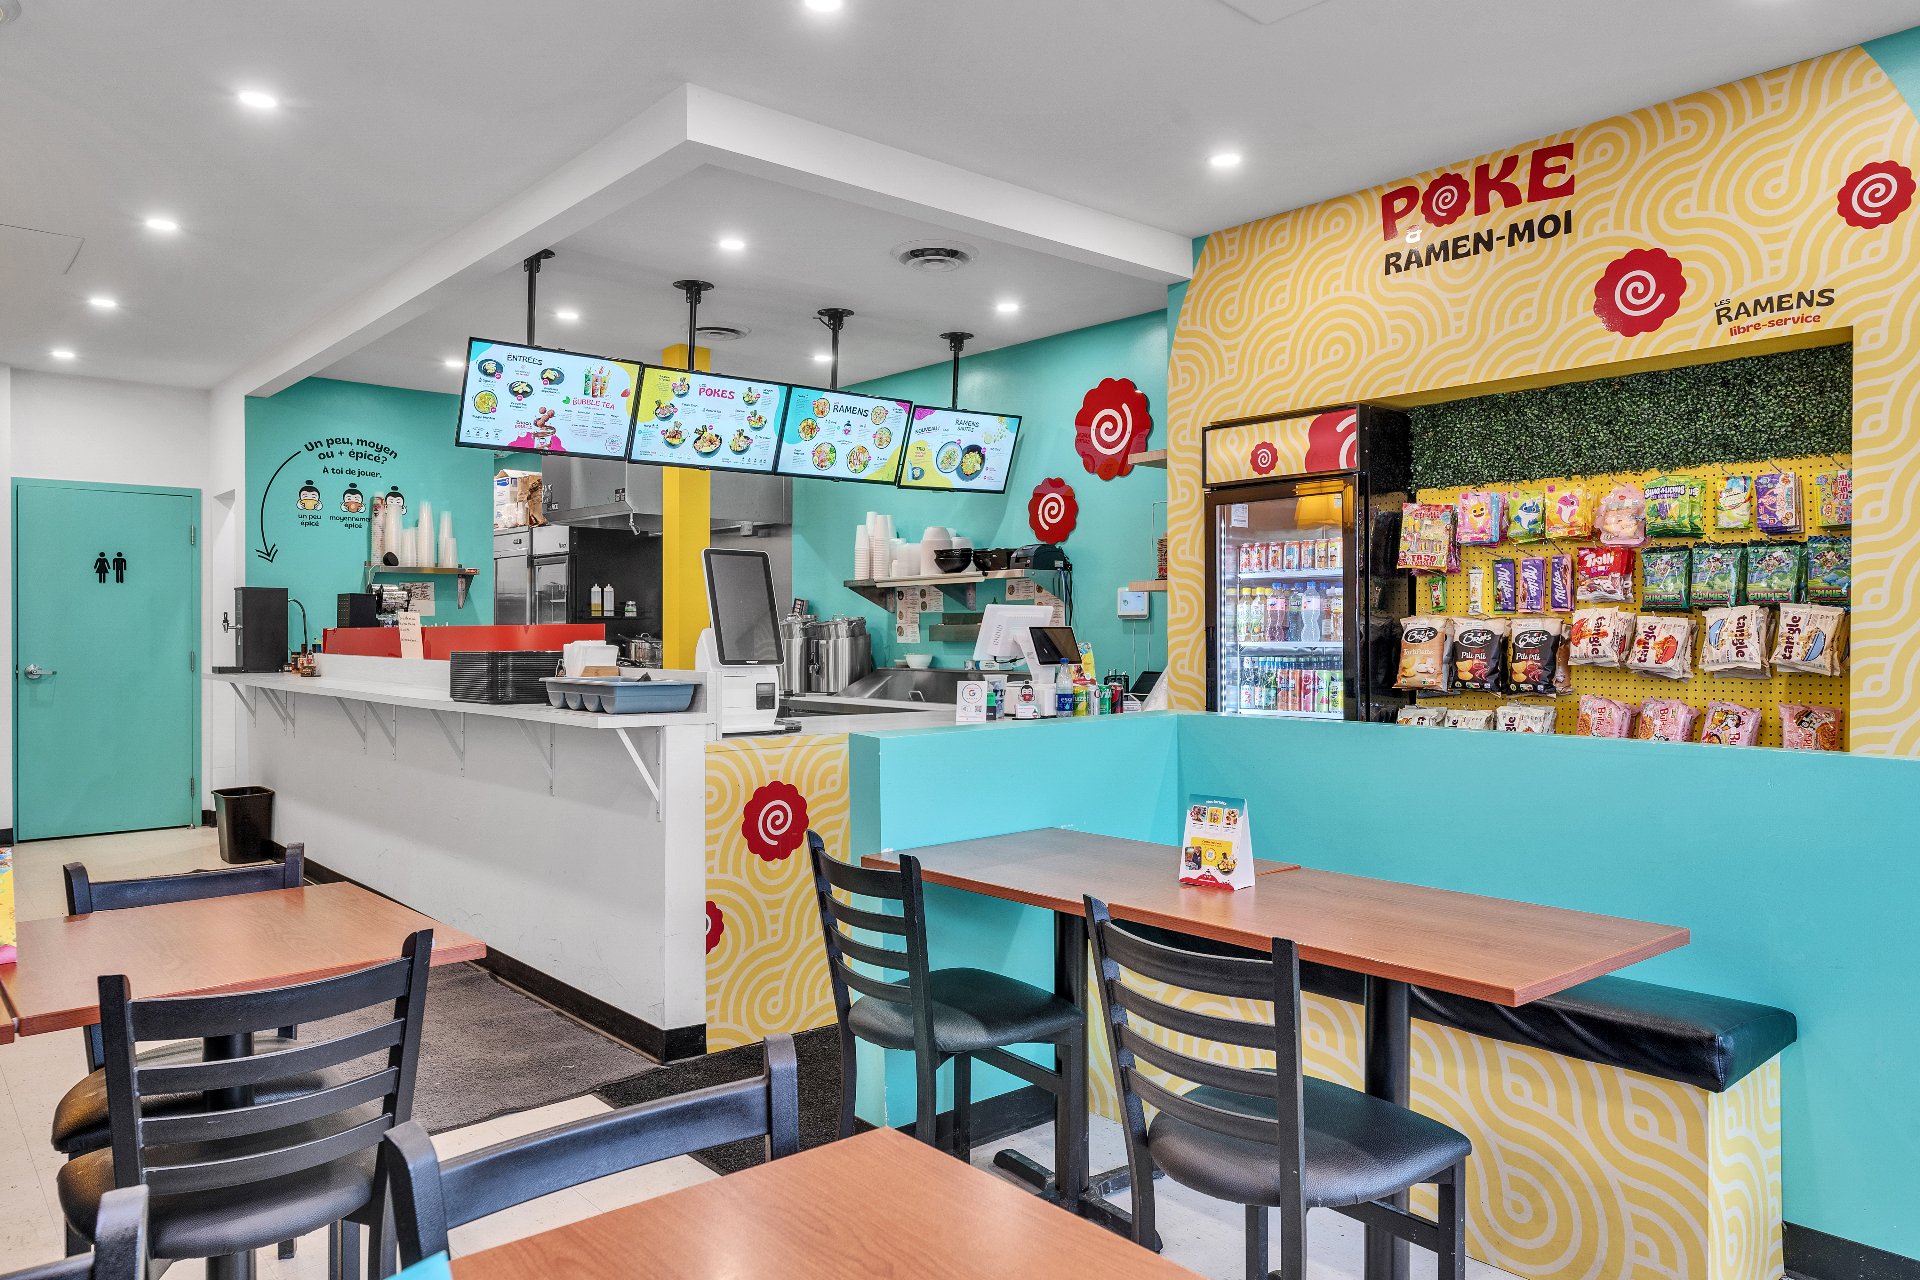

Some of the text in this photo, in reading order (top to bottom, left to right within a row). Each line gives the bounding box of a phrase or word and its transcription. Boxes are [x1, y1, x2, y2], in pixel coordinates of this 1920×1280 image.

[1384, 210, 1573, 276] RAMEN-MOI
[1714, 297, 1731, 308] LES
[1715, 288, 1836, 327] RAMENS
[1729, 313, 1821, 337] libre-service
[698, 387, 736, 400] POKES
[832, 404, 869, 418] RAMENS
[304, 435, 399, 459] Un peu, moyen
[318, 450, 335, 460] ou
[348, 448, 388, 465] épicé?
[331, 466, 343, 475] toi
[345, 467, 356, 476] de
[357, 468, 382, 479] jouer.
[1584, 551, 1615, 568] Trolli
[1496, 567, 1514, 599] Milka
[1522, 566, 1540, 598] Milka
[1553, 570, 1567, 603] Milka
[1692, 592, 1729, 600] GUMMIES
[1749, 592, 1789, 601] GUMMIES
[1636, 625, 1657, 664] tangle
[1731, 615, 1748, 658] tangle
[1781, 615, 1802, 660] tangle
